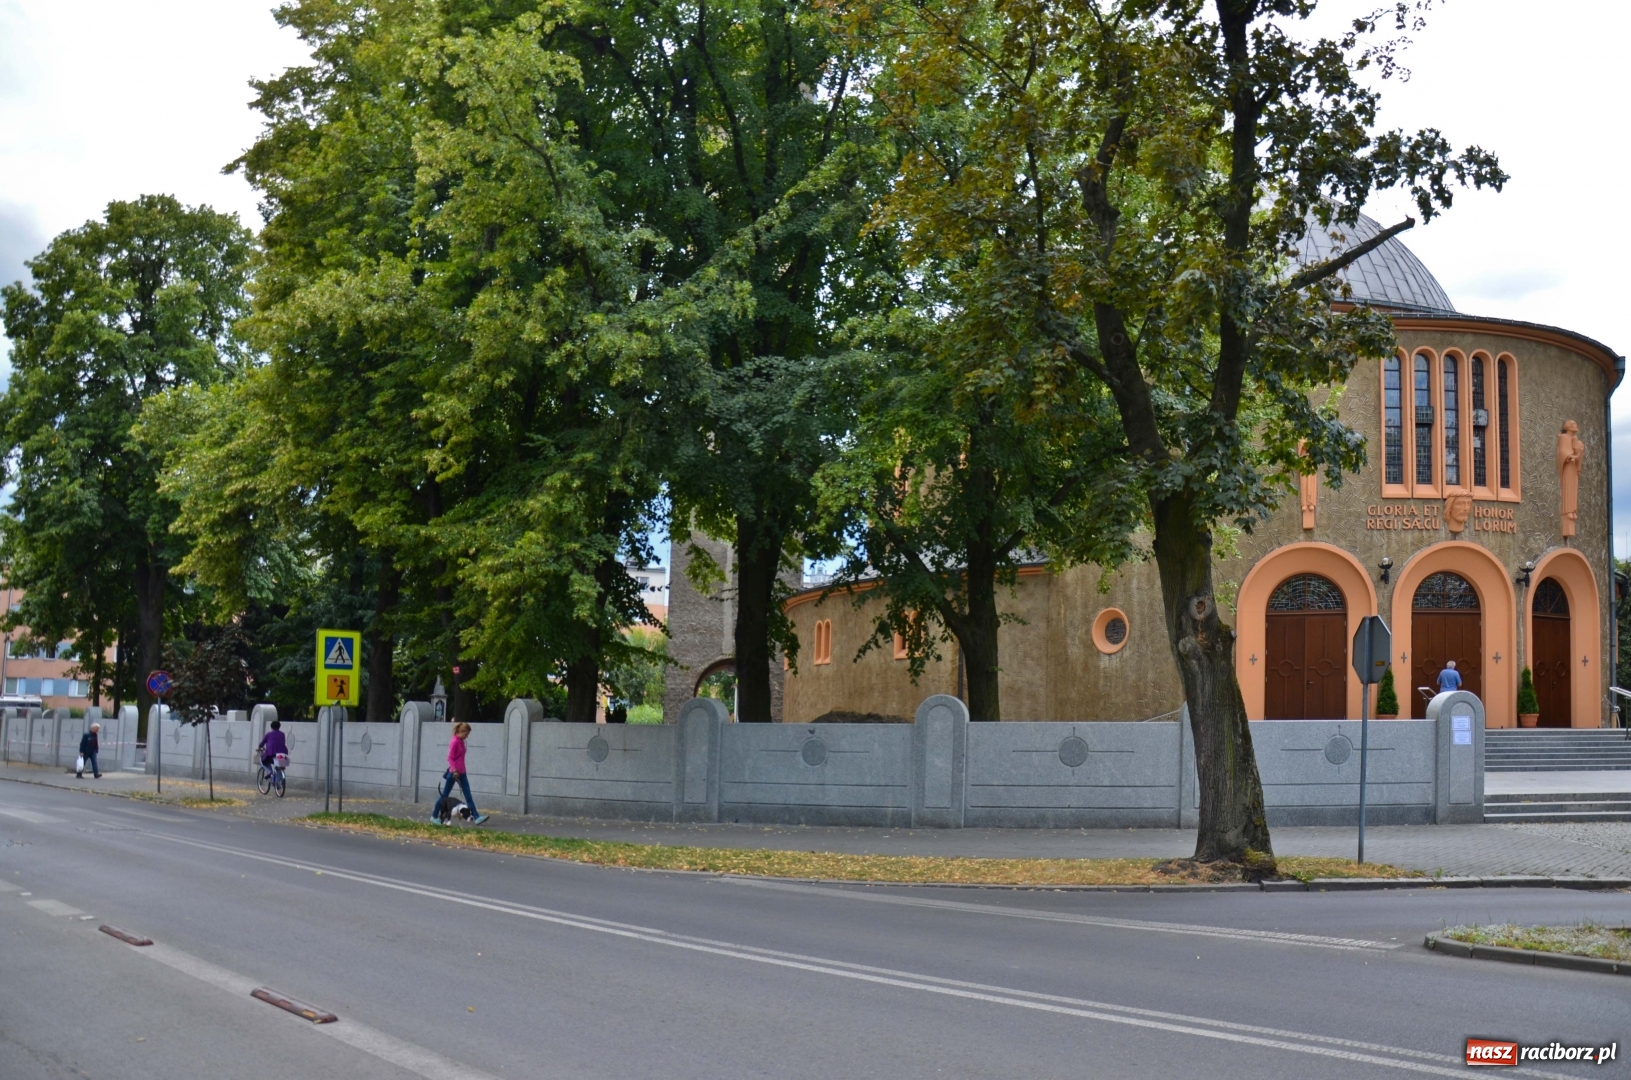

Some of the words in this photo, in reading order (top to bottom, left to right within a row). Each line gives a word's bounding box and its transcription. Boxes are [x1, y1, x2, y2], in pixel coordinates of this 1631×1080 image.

[1367, 504, 1418, 517] GLORIA
[1423, 504, 1440, 517] ET
[1474, 506, 1514, 519] HONOR
[1366, 518, 1398, 530] REGI
[1474, 520, 1517, 533] LORUM
